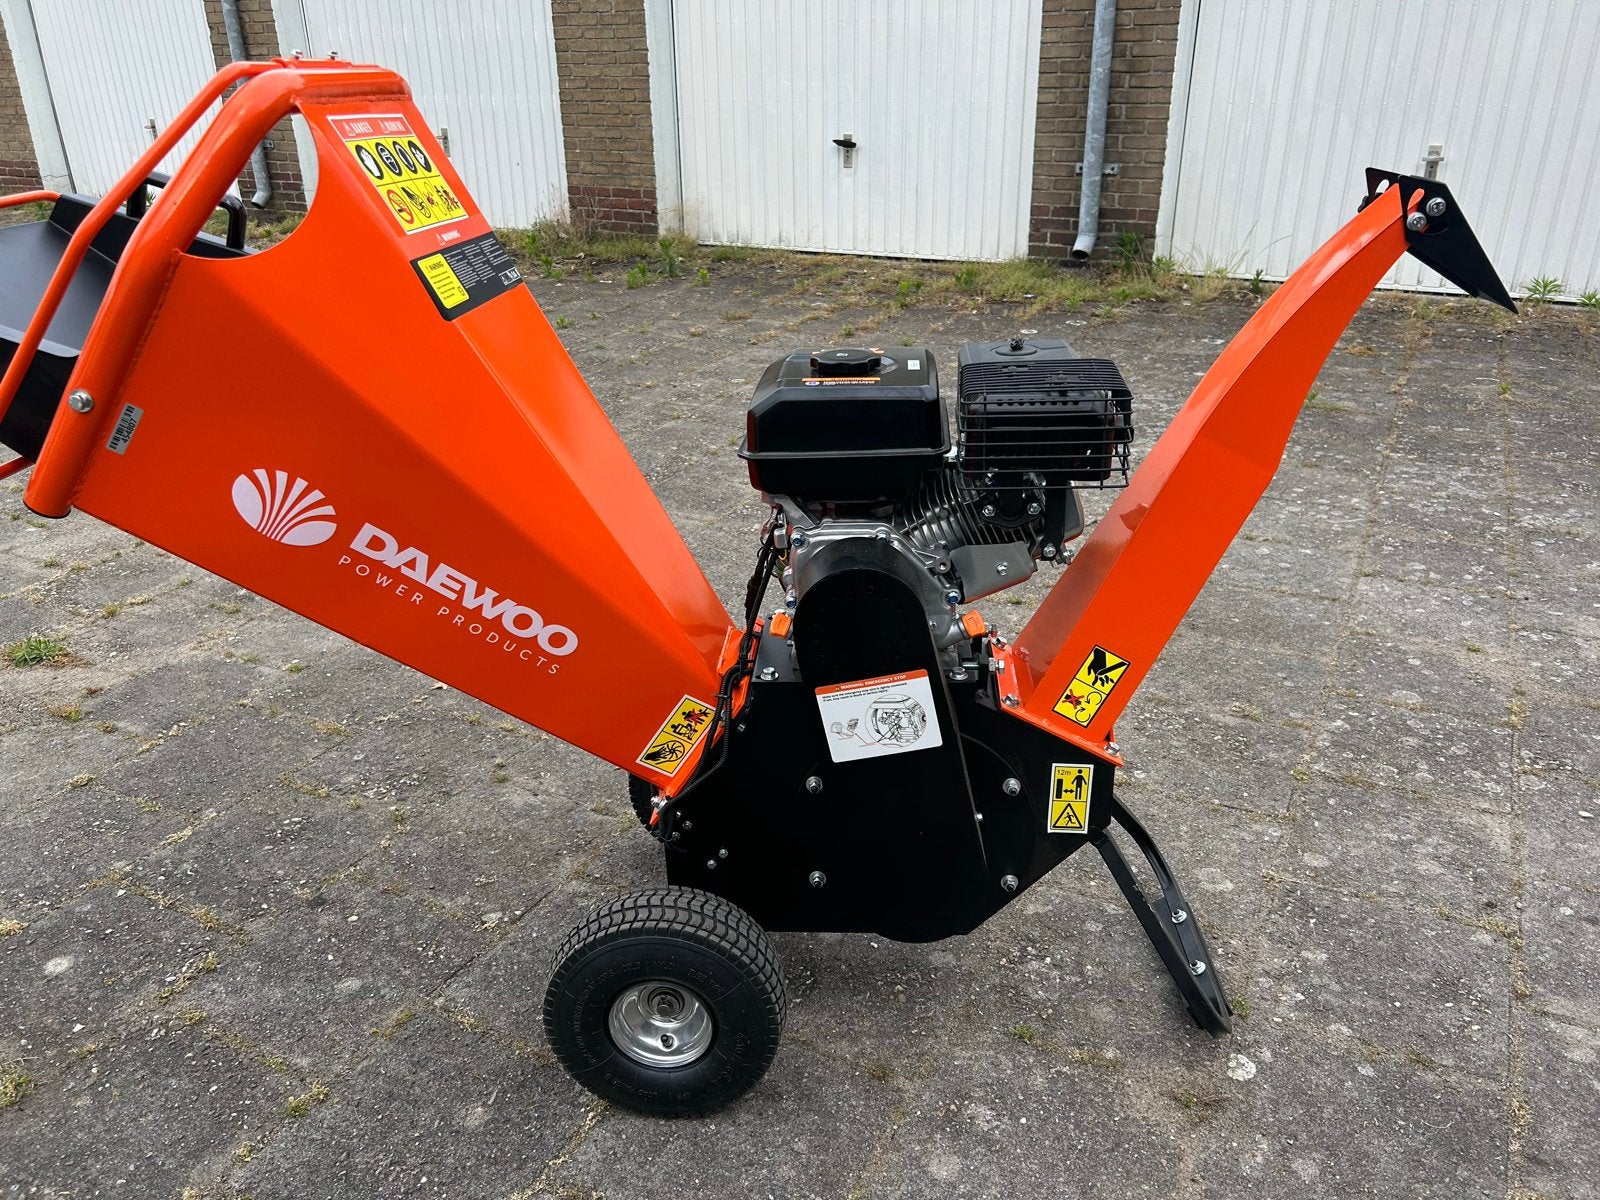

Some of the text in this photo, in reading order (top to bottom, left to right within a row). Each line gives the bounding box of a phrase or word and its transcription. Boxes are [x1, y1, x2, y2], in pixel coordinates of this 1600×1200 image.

[338, 555, 560, 675] POWER PRODUCTS
[349, 522, 579, 657] DAEWOO
[865, 677, 893, 685] EMERGENCY
